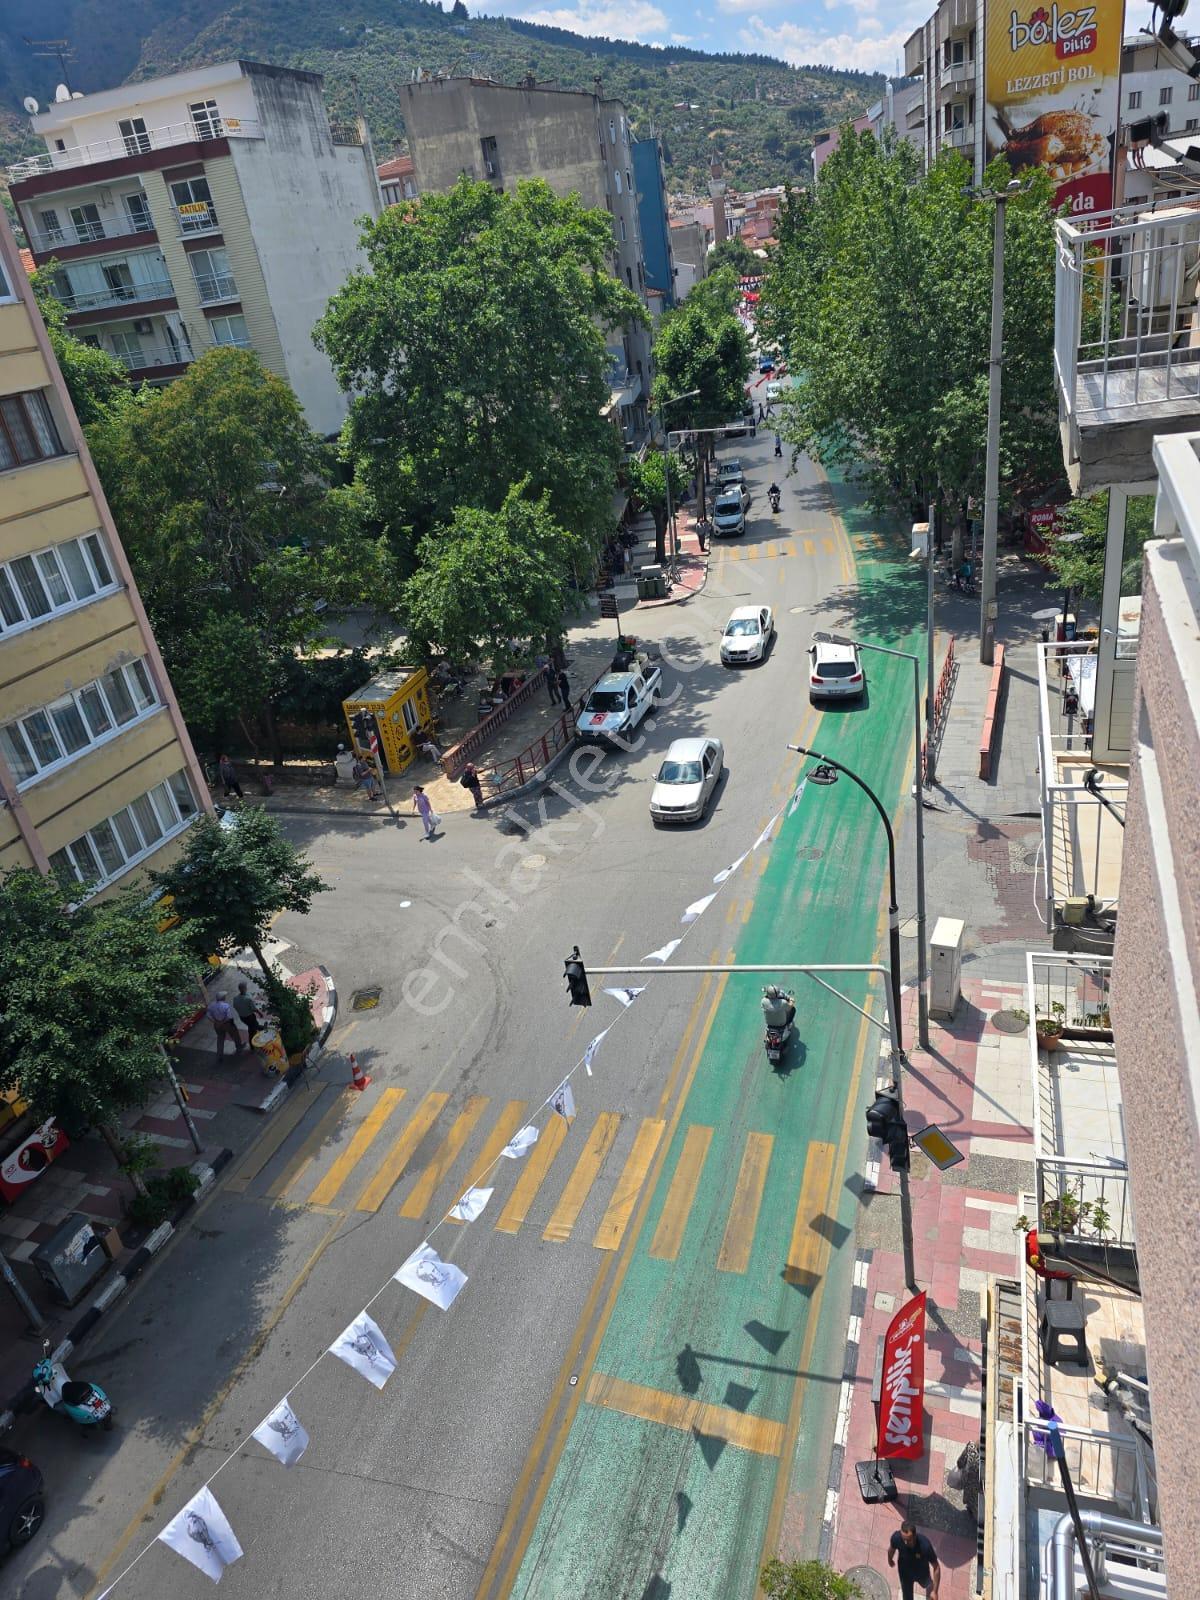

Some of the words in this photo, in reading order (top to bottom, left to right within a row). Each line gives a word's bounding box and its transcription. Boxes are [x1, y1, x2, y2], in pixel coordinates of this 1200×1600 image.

[1009, 2, 1097, 52] bolez
[1007, 66, 1065, 93] LEZZETİ
[1068, 65, 1096, 81] BOL
